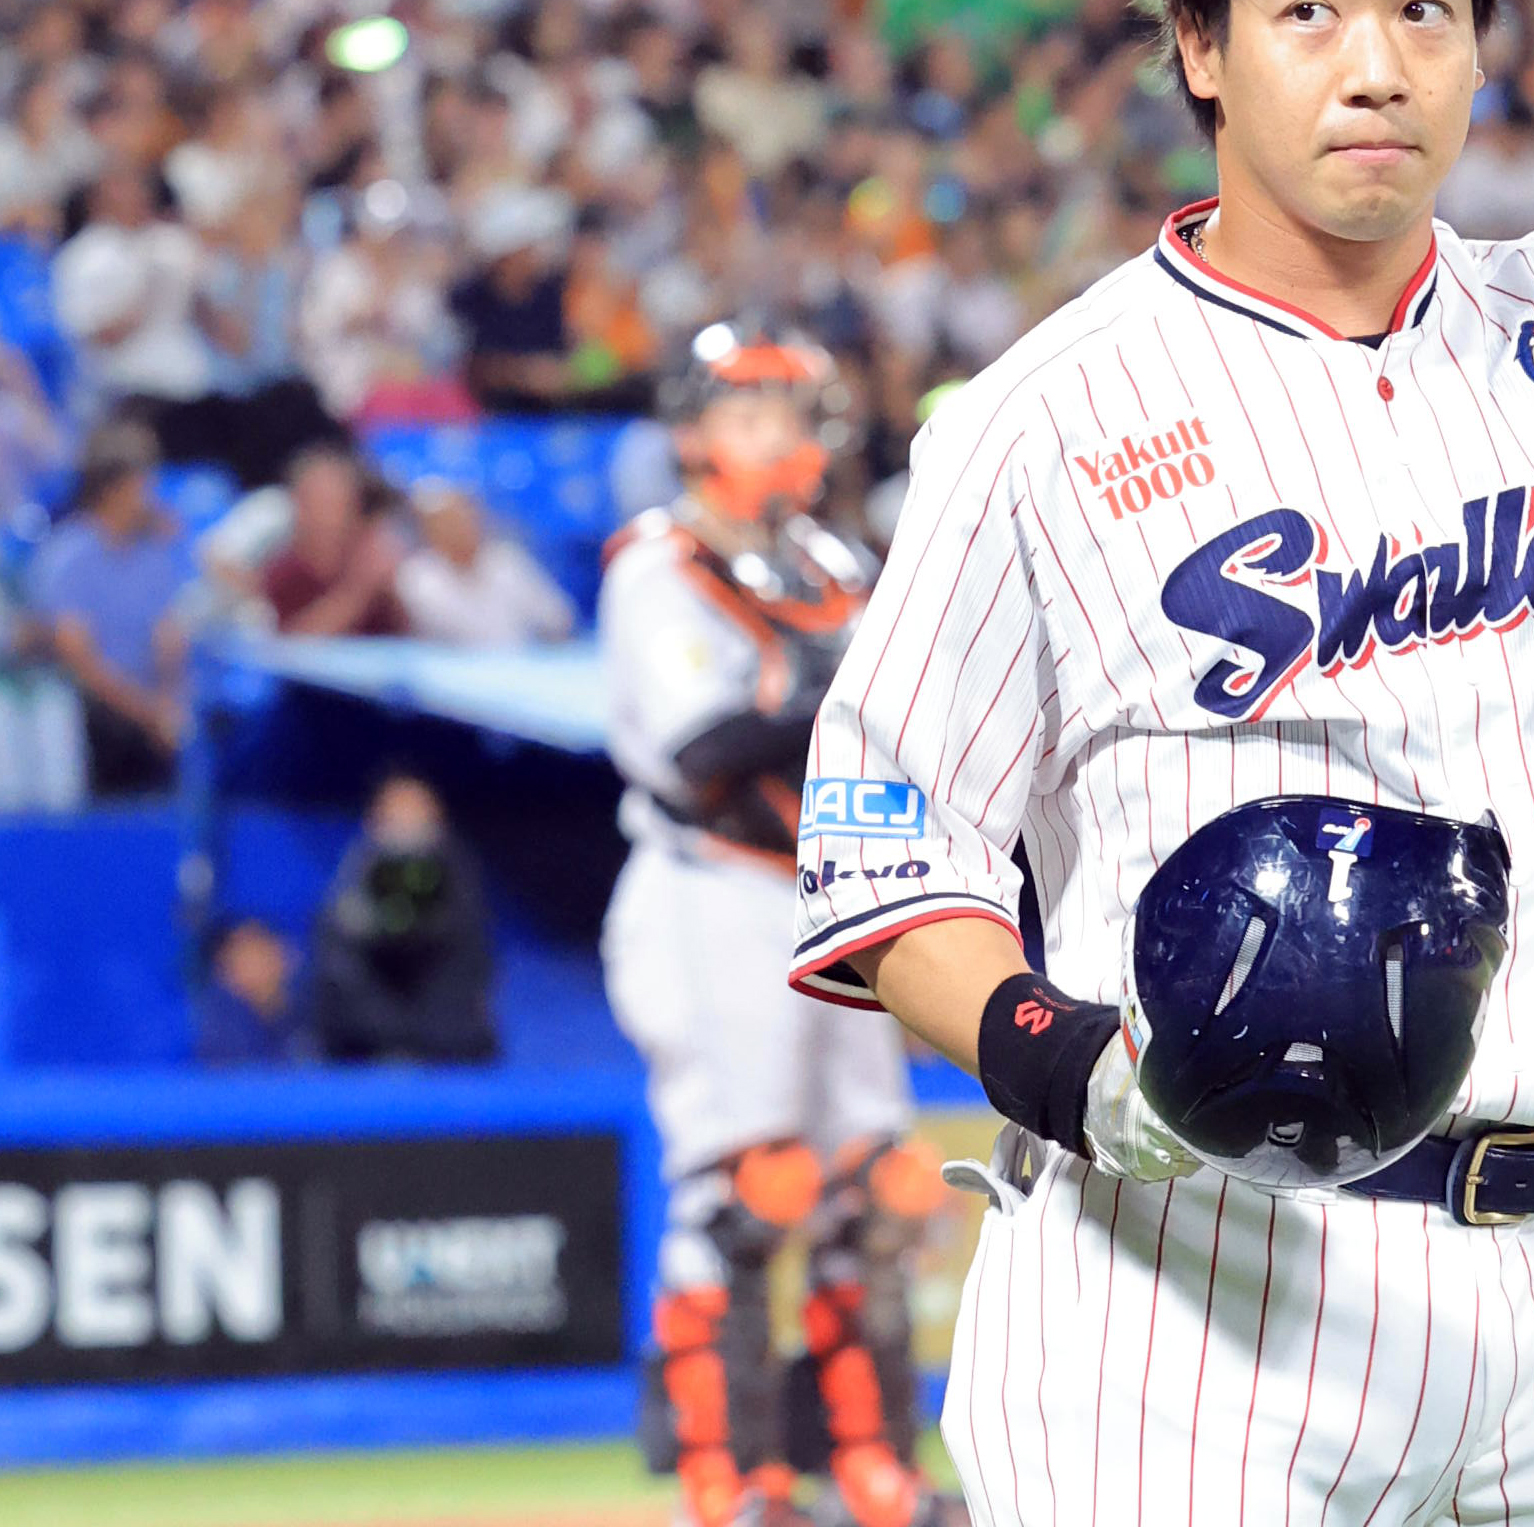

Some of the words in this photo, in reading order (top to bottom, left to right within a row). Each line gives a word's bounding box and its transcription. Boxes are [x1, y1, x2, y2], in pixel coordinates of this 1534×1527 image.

[1073, 416, 1213, 487] Yakult
[1098, 452, 1215, 520] 1000
[800, 781, 919, 826] UACJ
